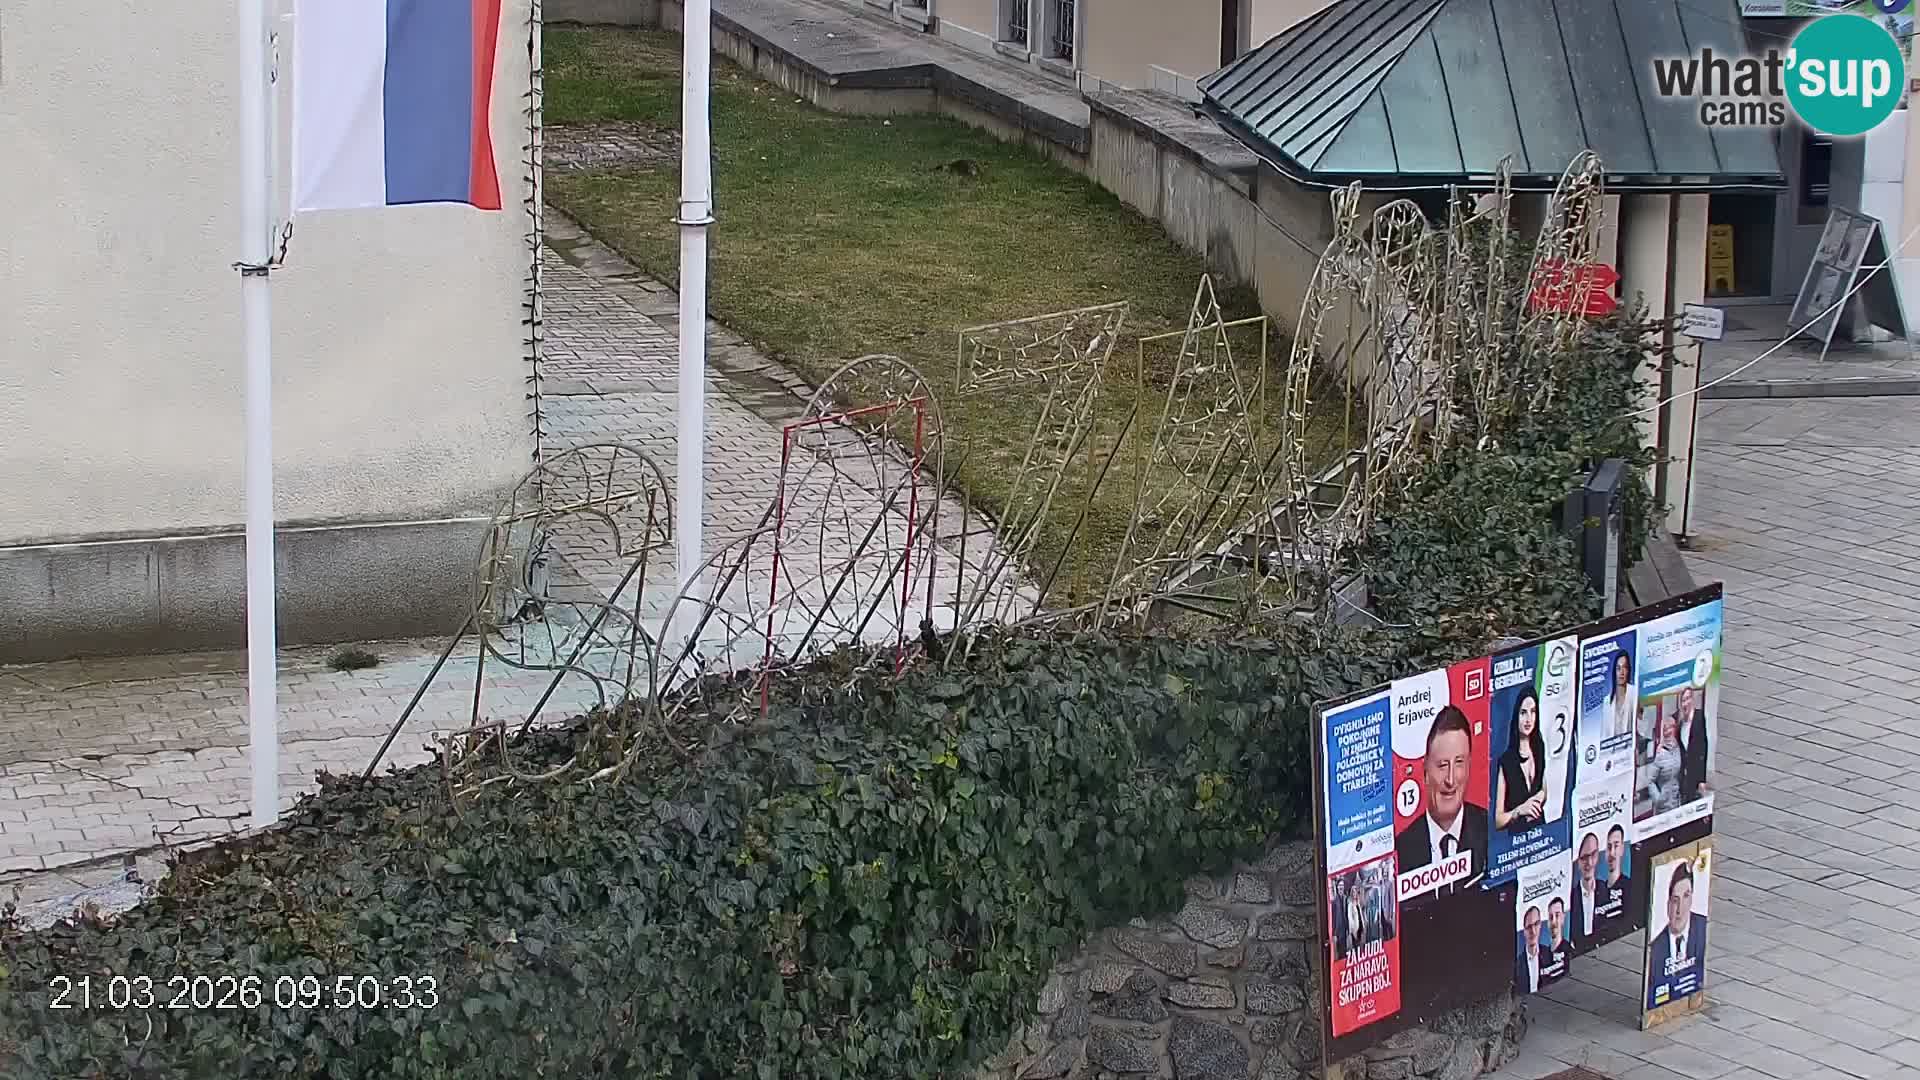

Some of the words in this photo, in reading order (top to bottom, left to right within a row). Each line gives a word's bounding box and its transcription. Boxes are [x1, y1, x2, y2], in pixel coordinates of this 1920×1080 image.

[1469, 679, 1480, 691] SD
[1398, 686, 1432, 708] Andrej
[1333, 717, 1366, 737] DVIGNILI
[1367, 711, 1384, 725] SMO
[1398, 706, 1435, 726] Erjavec
[1338, 725, 1381, 748] POKOJNINE
[1553, 712, 1566, 755] 3
[1336, 749, 1378, 773] POLOŽNICE
[1341, 746, 1349, 759] IN
[1336, 763, 1373, 784] DOMOVIH
[1374, 759, 1384, 772] ZA
[1402, 789, 1415, 807] 13
[1512, 835, 1526, 846] Ana
[1497, 848, 1518, 864] ZELENI
[1401, 857, 1468, 895] DOGOVOR
[1346, 948, 1358, 967] ZA
[1340, 968, 1353, 987] ZA
[1354, 956, 1389, 983] NARAVO.
[1339, 979, 1374, 1007] SKUPEN
[1374, 972, 1392, 993] BOJ.
